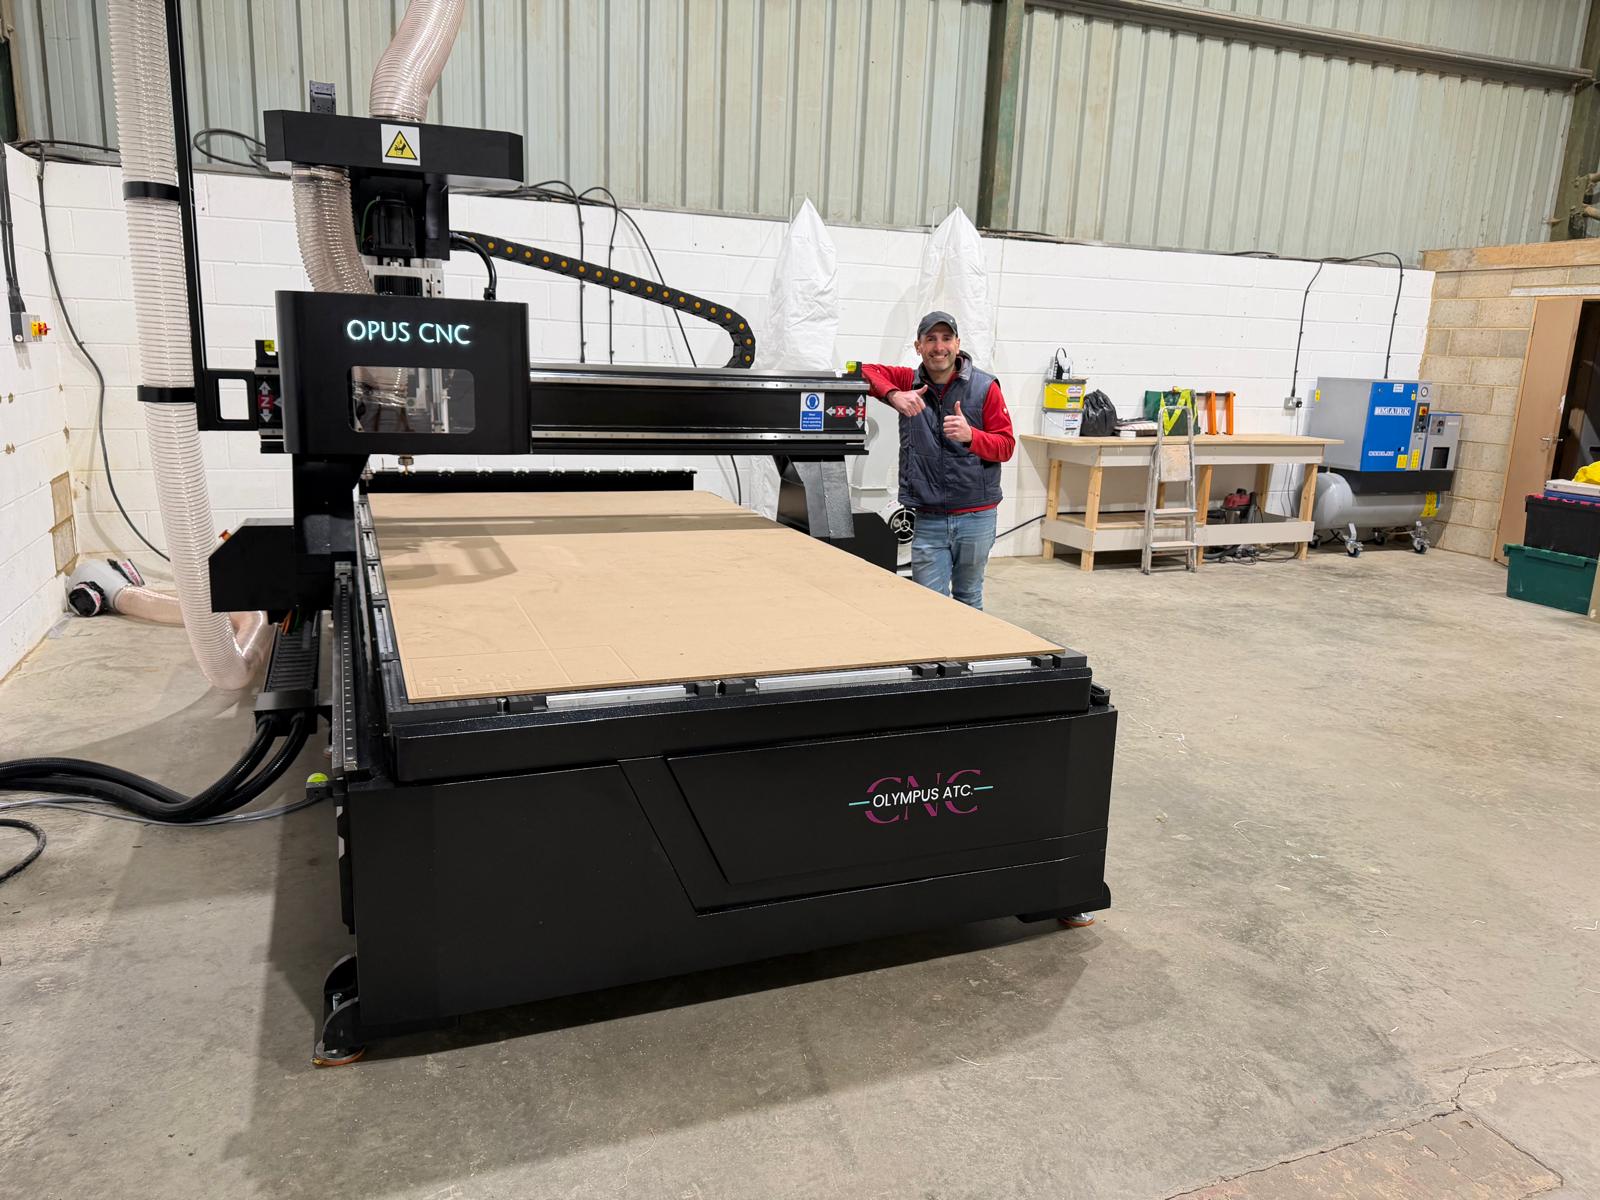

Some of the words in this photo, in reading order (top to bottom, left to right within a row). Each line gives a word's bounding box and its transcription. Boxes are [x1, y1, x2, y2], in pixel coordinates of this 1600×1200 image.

[346, 319, 411, 342] OPUS
[418, 322, 472, 345] CNC
[261, 396, 270, 407] Z
[837, 407, 844, 416] X
[857, 407, 864, 416] Z
[872, 787, 940, 808] OLYMPUS
